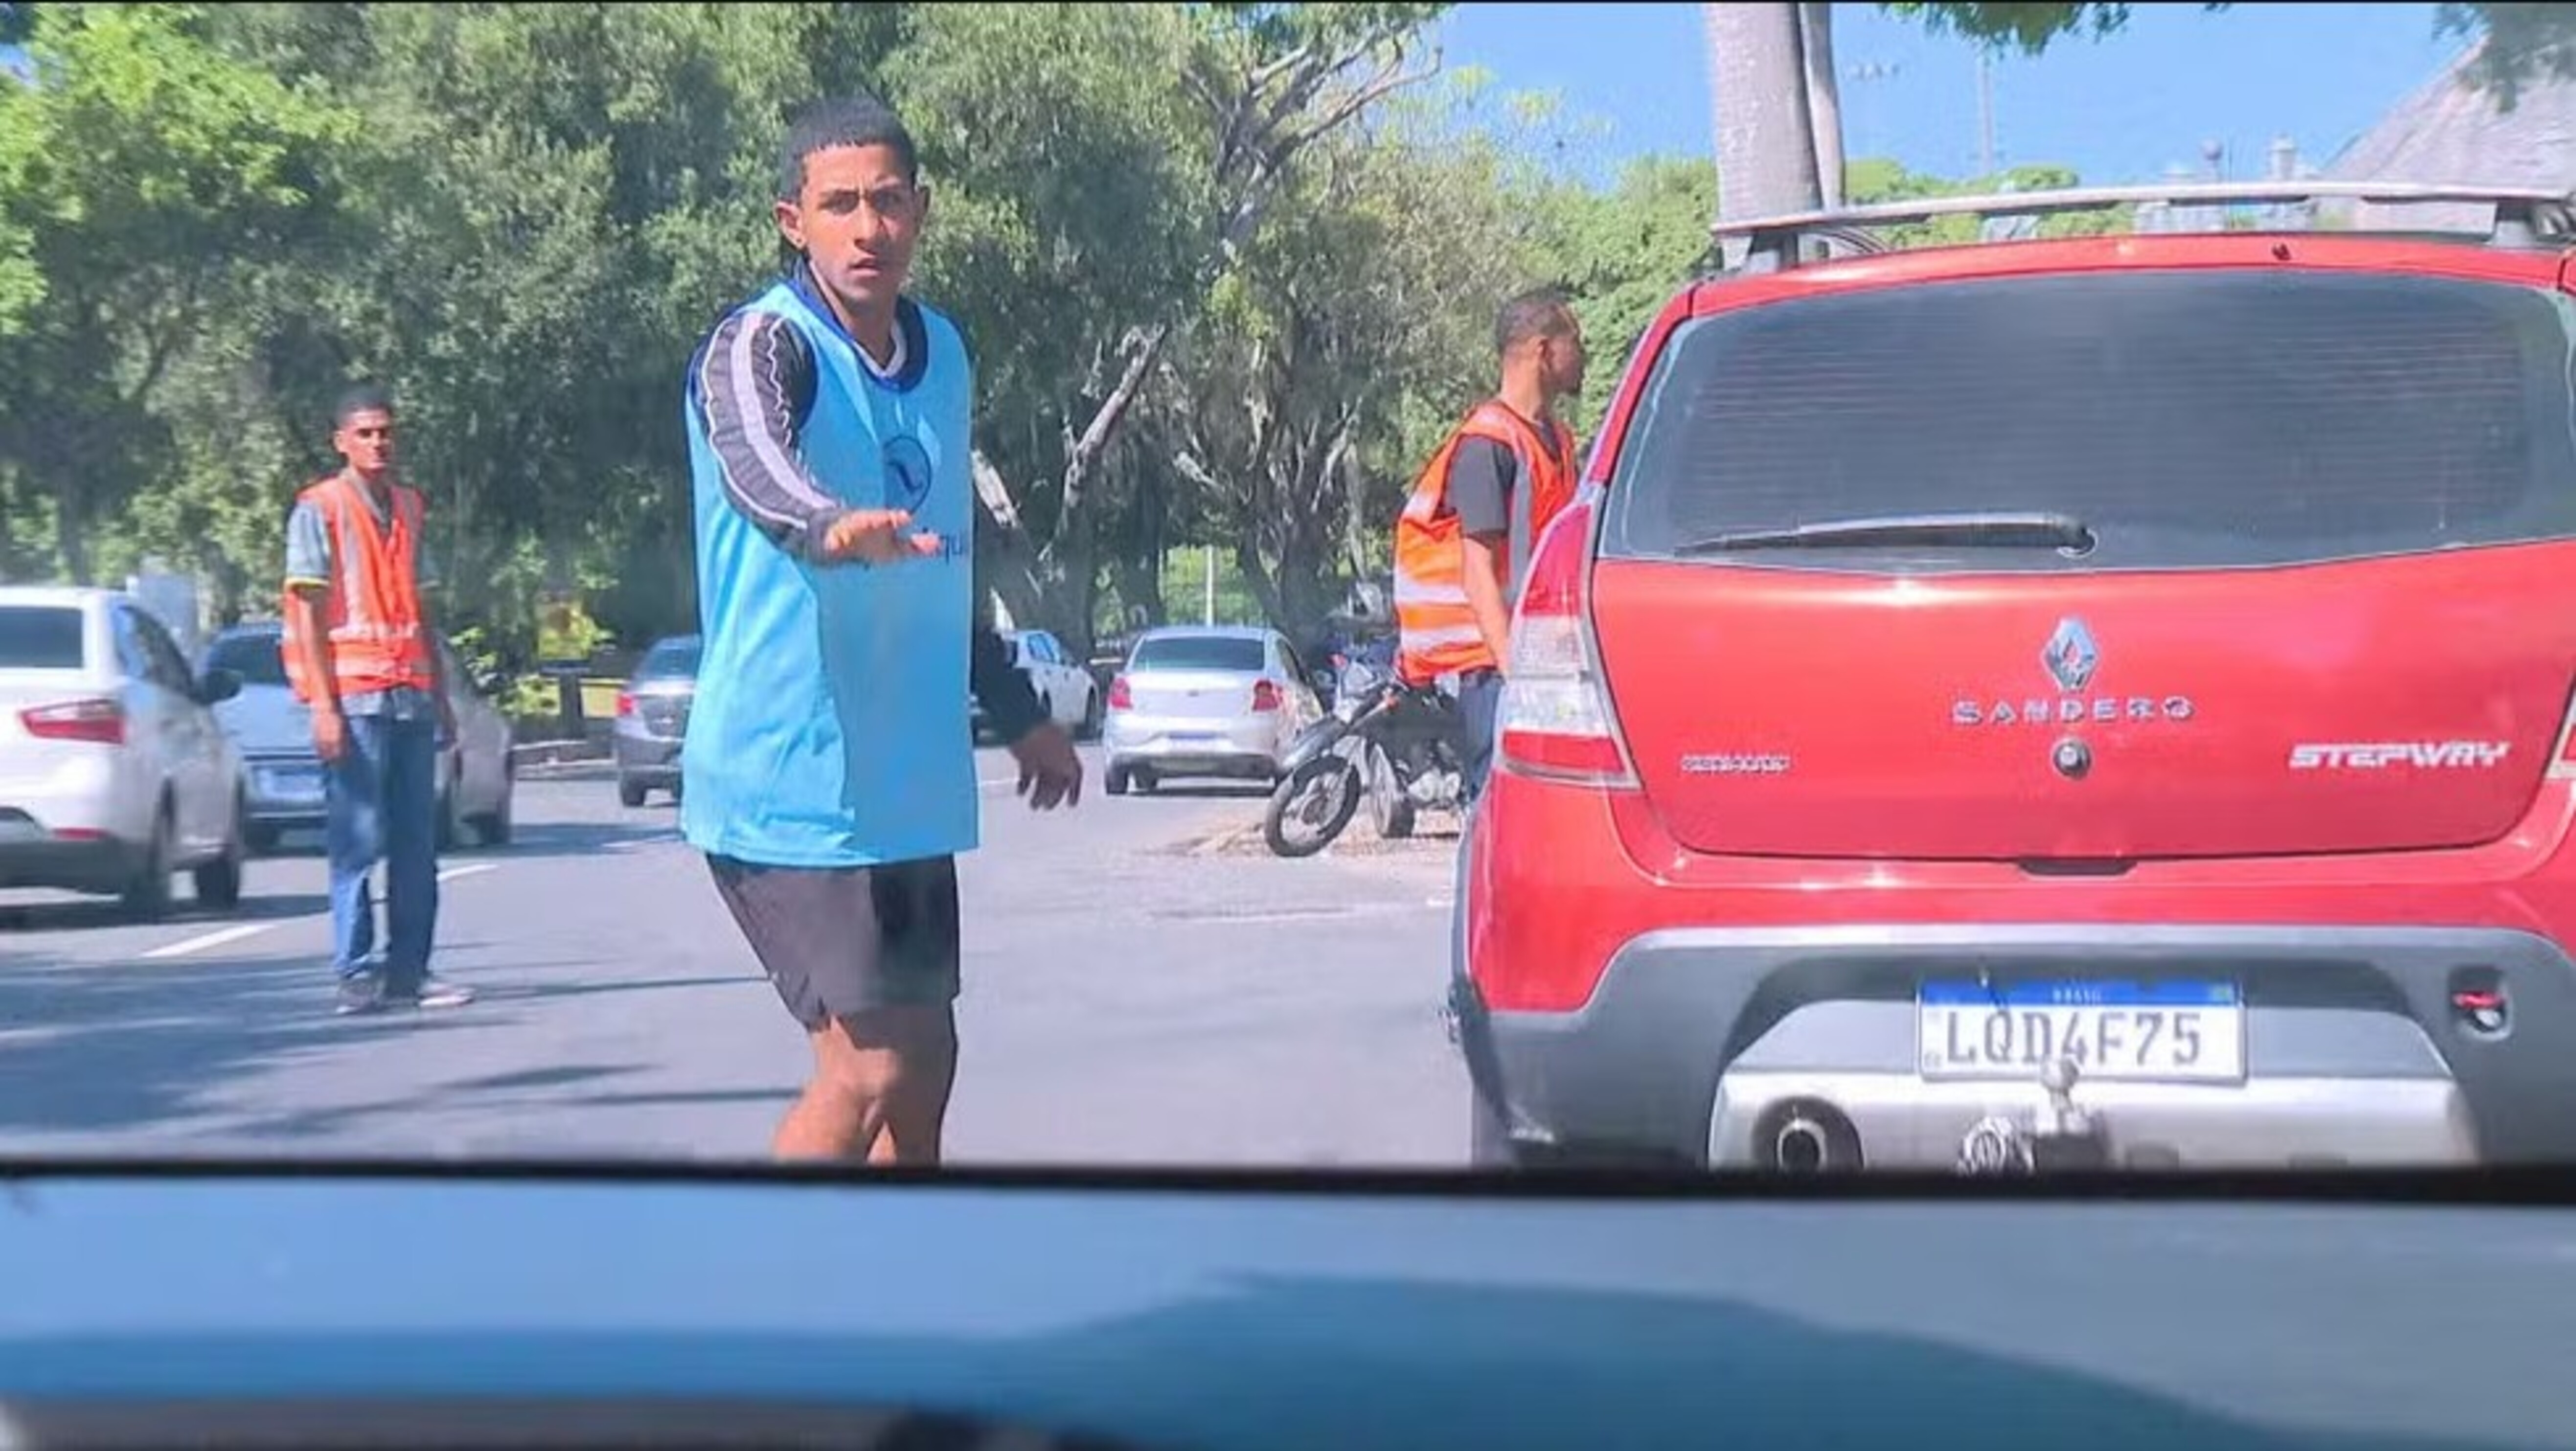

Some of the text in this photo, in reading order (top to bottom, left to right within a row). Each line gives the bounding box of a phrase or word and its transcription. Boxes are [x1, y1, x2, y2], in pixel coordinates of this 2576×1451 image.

[1953, 695, 2194, 725] SANDERO
[2289, 741, 2511, 769] STEPWAY
[1947, 1011, 2201, 1065] LQD4F75
